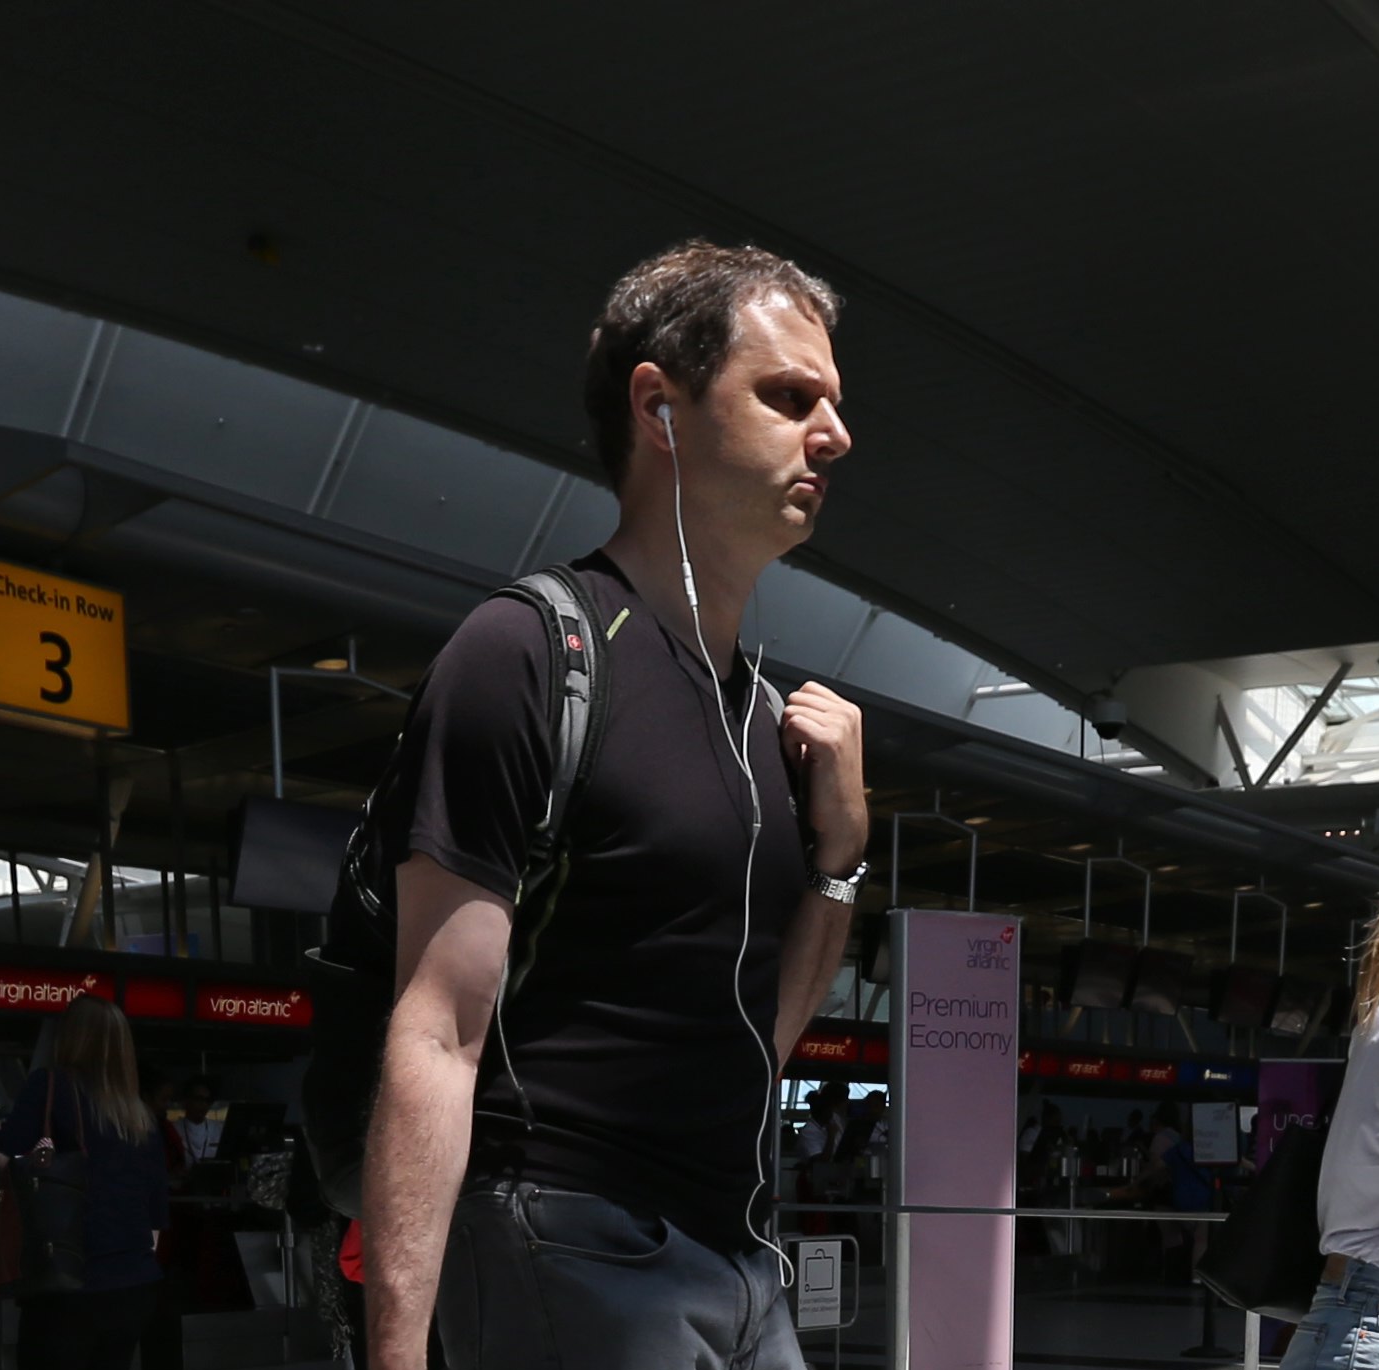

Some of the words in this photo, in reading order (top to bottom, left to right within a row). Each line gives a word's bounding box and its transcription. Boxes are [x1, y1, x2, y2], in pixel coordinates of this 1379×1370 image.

[76, 596, 114, 621] Row
[39, 630, 72, 704] 3
[967, 936, 1004, 955] virgin
[967, 952, 1010, 970] atlantic
[210, 995, 246, 1018] virgin
[247, 997, 292, 1019] atlantic
[910, 991, 1009, 1019] Premium
[910, 1024, 1013, 1056] Economy
